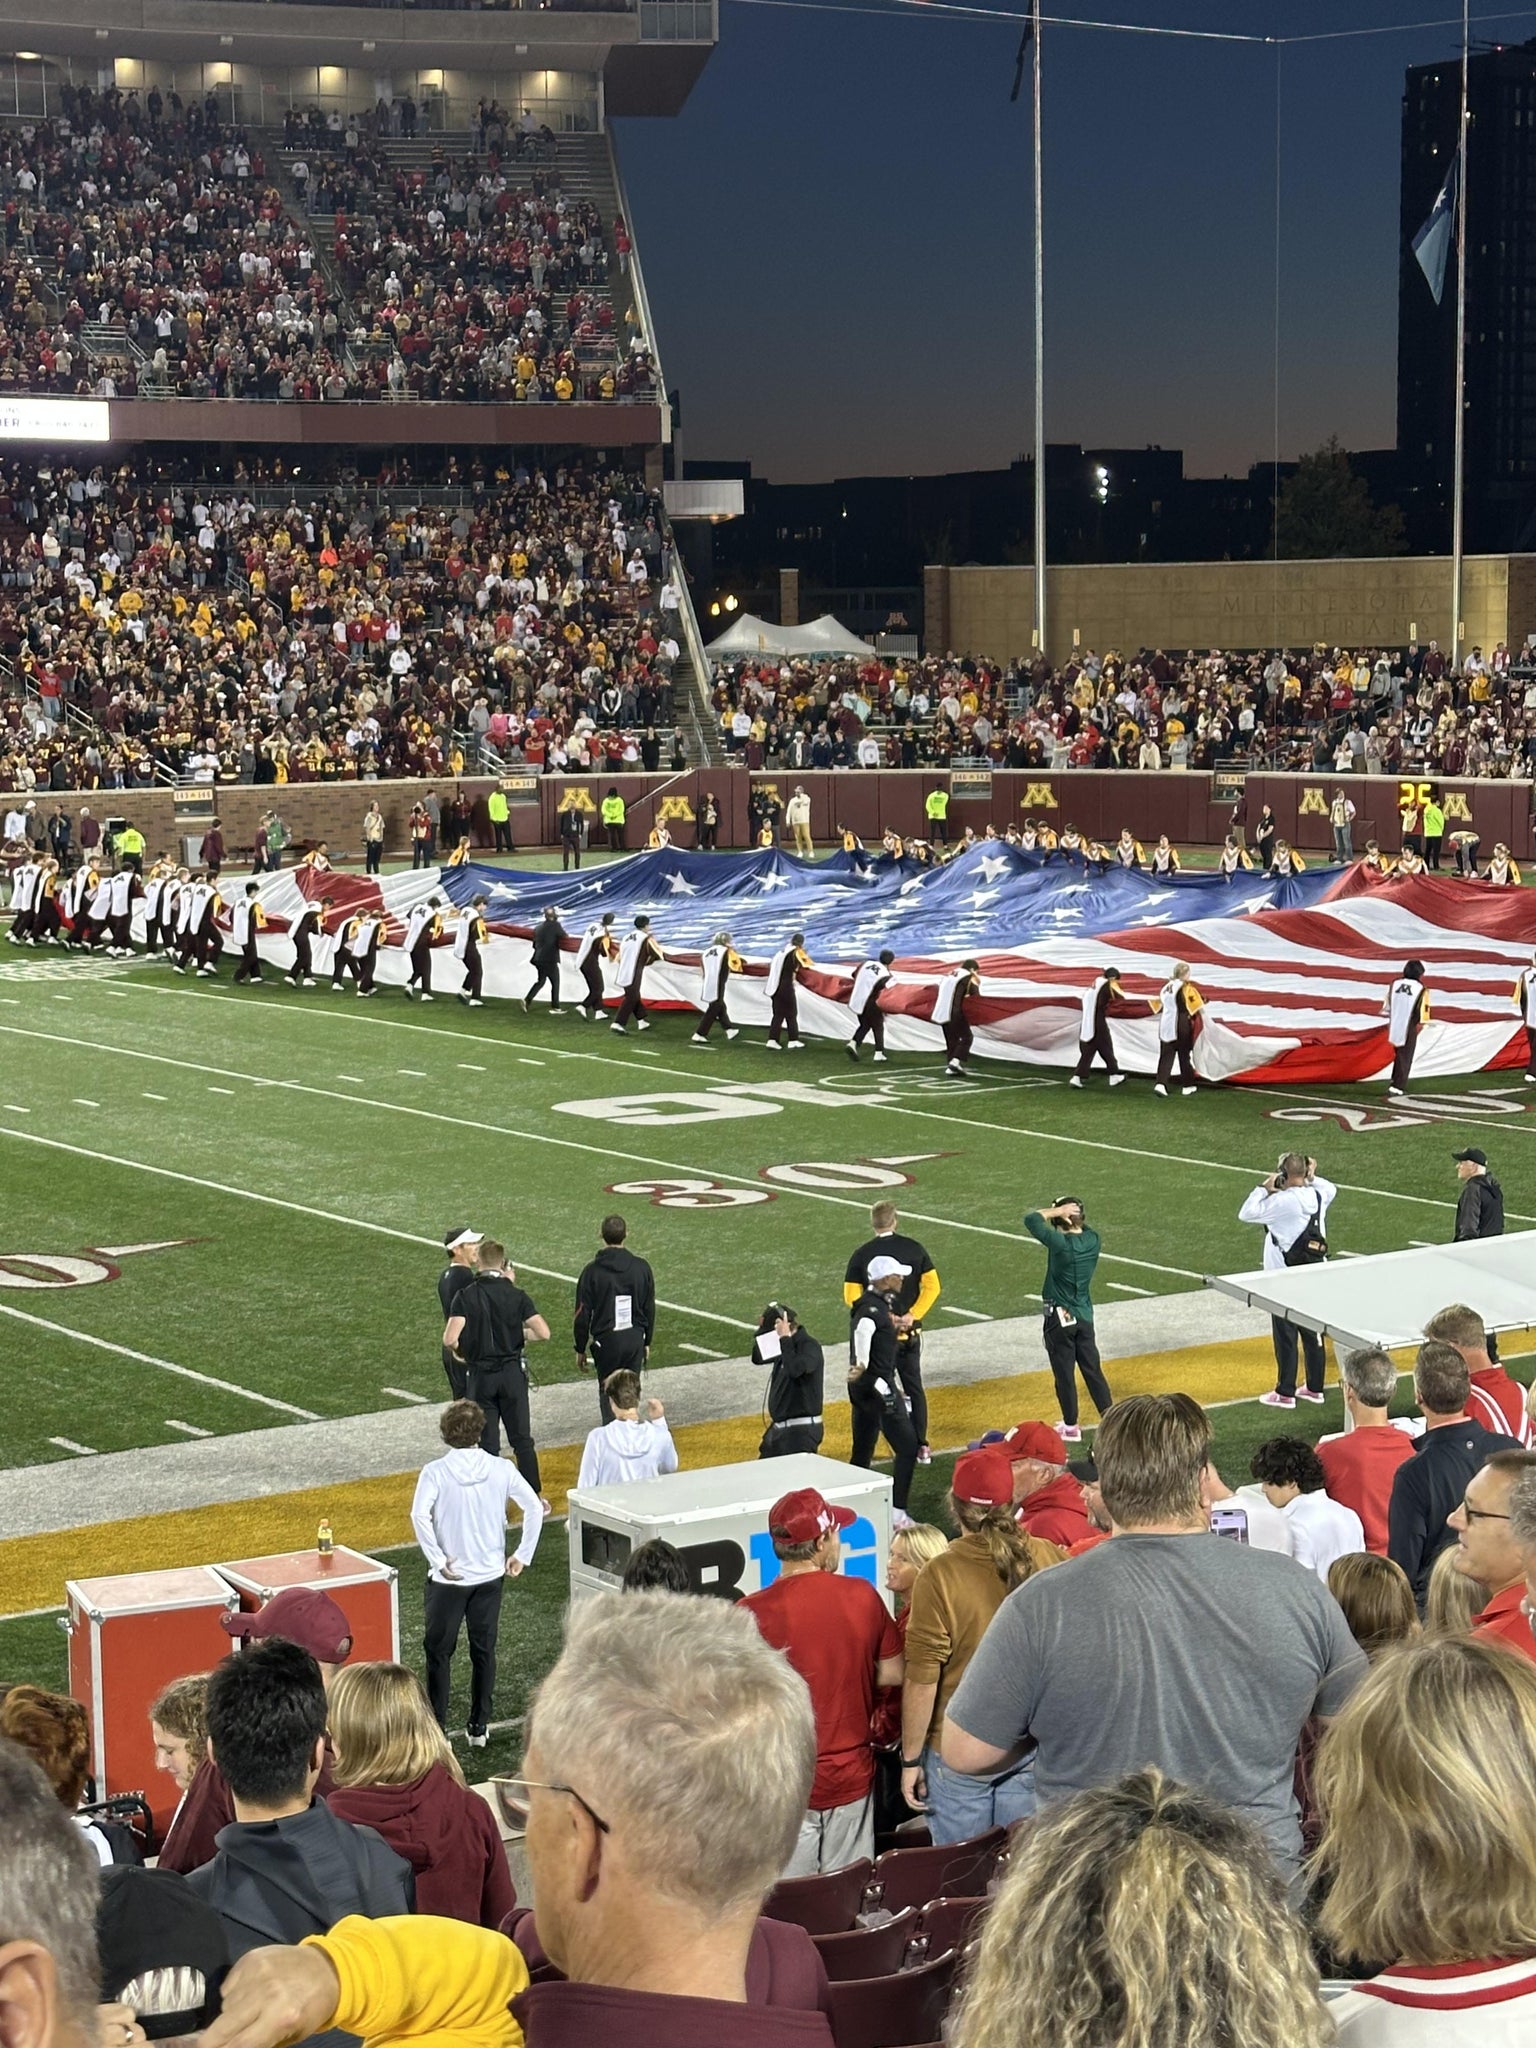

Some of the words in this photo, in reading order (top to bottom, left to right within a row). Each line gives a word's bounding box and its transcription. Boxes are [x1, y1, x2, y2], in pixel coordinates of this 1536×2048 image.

[1222, 592, 1433, 614] MINNESOTA
[1254, 617, 1429, 636] VETERANS
[1020, 783, 1058, 808] M
[1298, 788, 1330, 815] M
[1442, 793, 1473, 822] M
[655, 796, 696, 821] M
[603, 1161, 917, 1208] 30
